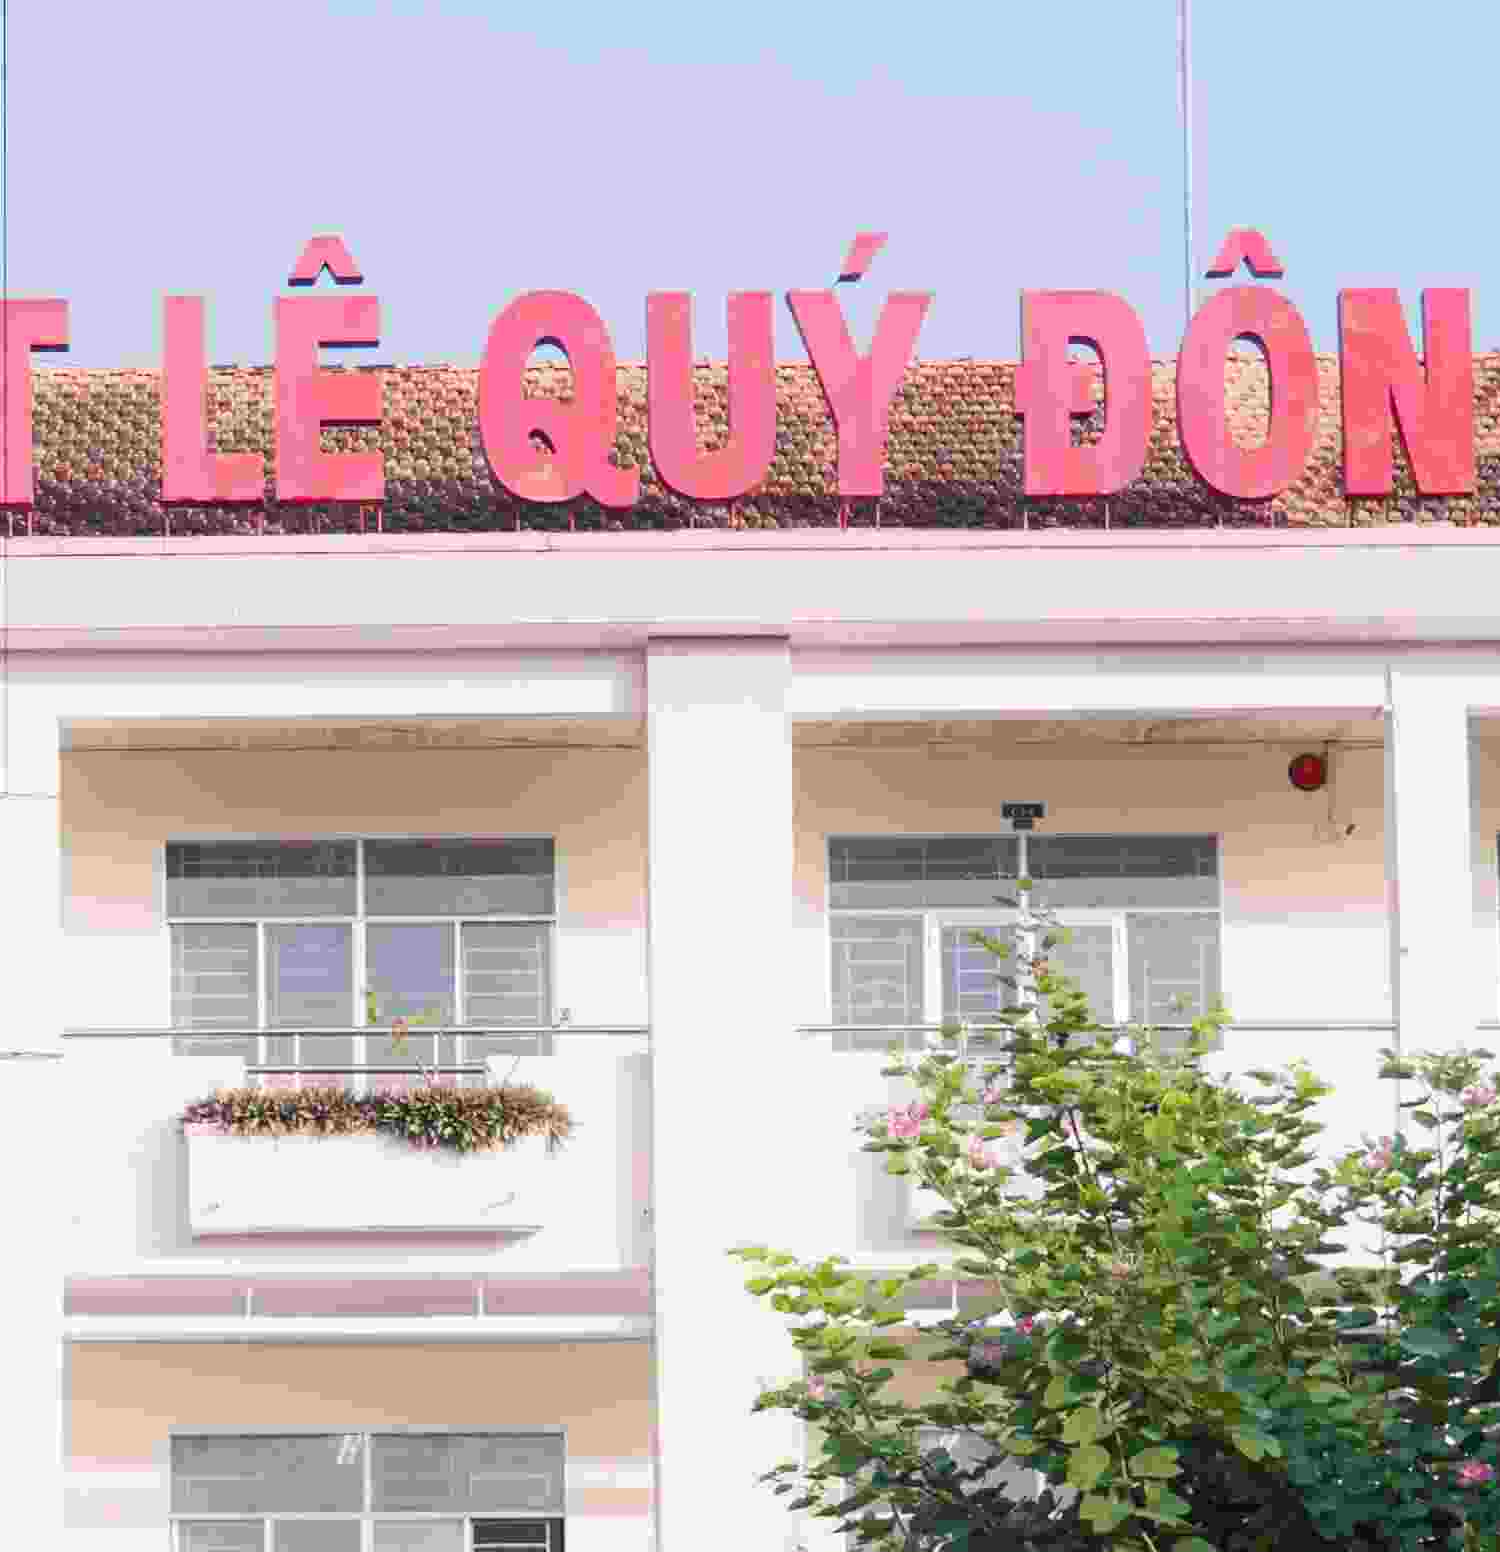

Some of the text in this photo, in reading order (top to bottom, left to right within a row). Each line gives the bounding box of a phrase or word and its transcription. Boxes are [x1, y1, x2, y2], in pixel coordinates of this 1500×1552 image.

[161, 233, 384, 505] LÊ
[476, 231, 935, 511] QUÝ
[1012, 227, 1474, 505] ĐÔN
